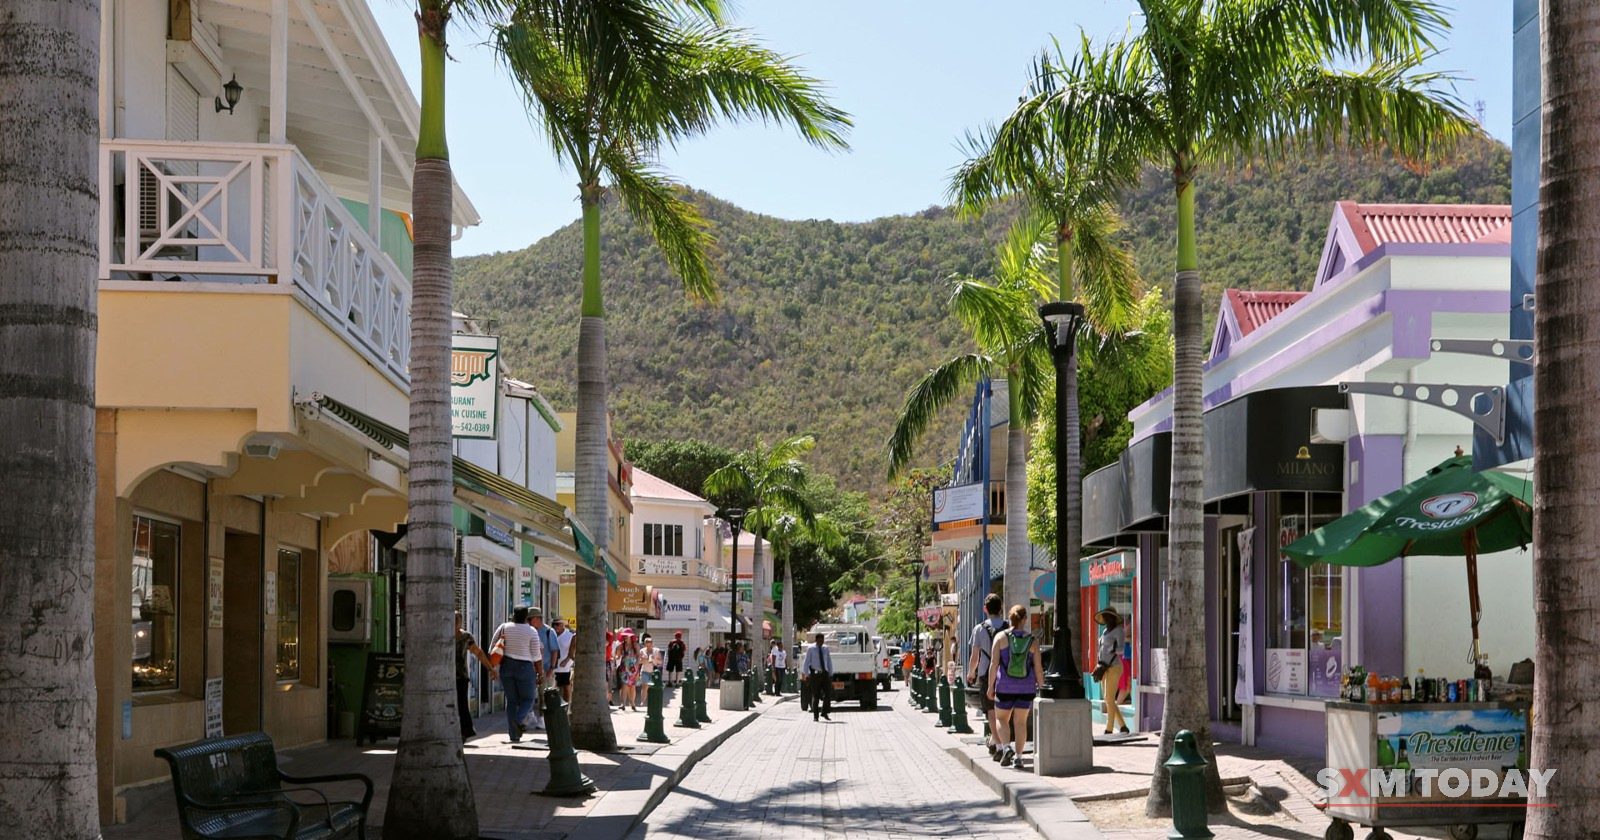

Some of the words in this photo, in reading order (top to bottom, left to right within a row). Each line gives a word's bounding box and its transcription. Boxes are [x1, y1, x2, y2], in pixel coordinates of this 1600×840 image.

[461, 409, 487, 419] CUISINE
[1276, 461, 1335, 475] MILANO
[666, 603, 691, 612] AVENUE
[1408, 731, 1516, 754] Presidente
